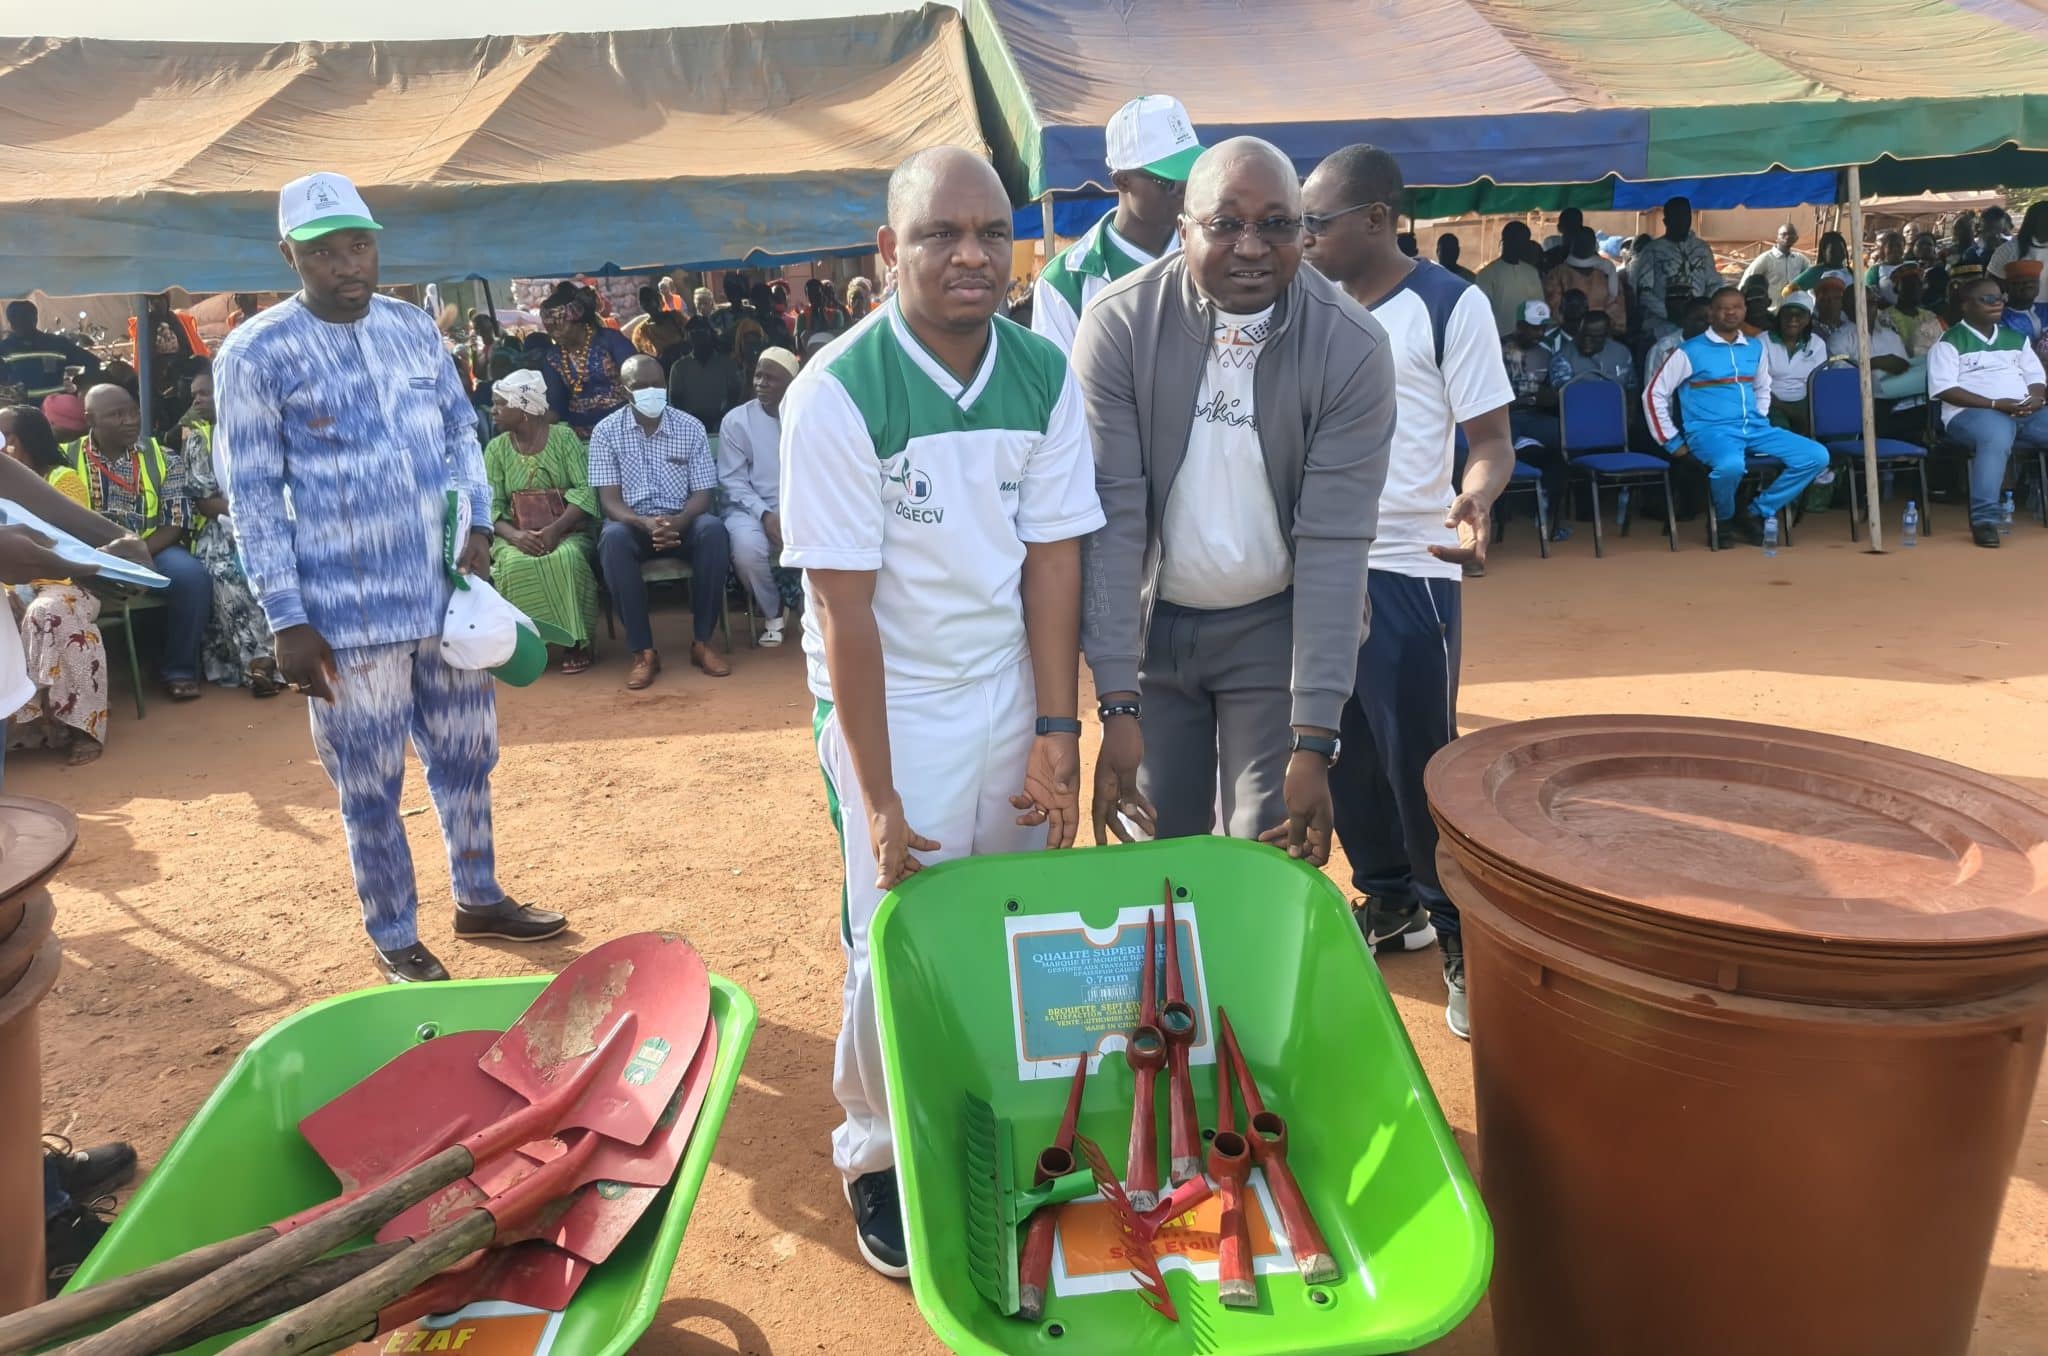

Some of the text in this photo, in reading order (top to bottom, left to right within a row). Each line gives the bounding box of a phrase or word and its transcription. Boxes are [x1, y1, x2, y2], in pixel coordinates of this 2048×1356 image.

[1032, 950, 1090, 964] QUALITE
[1086, 974, 1129, 984] 0.7mm
[384, 1327, 476, 1353] EZAF
